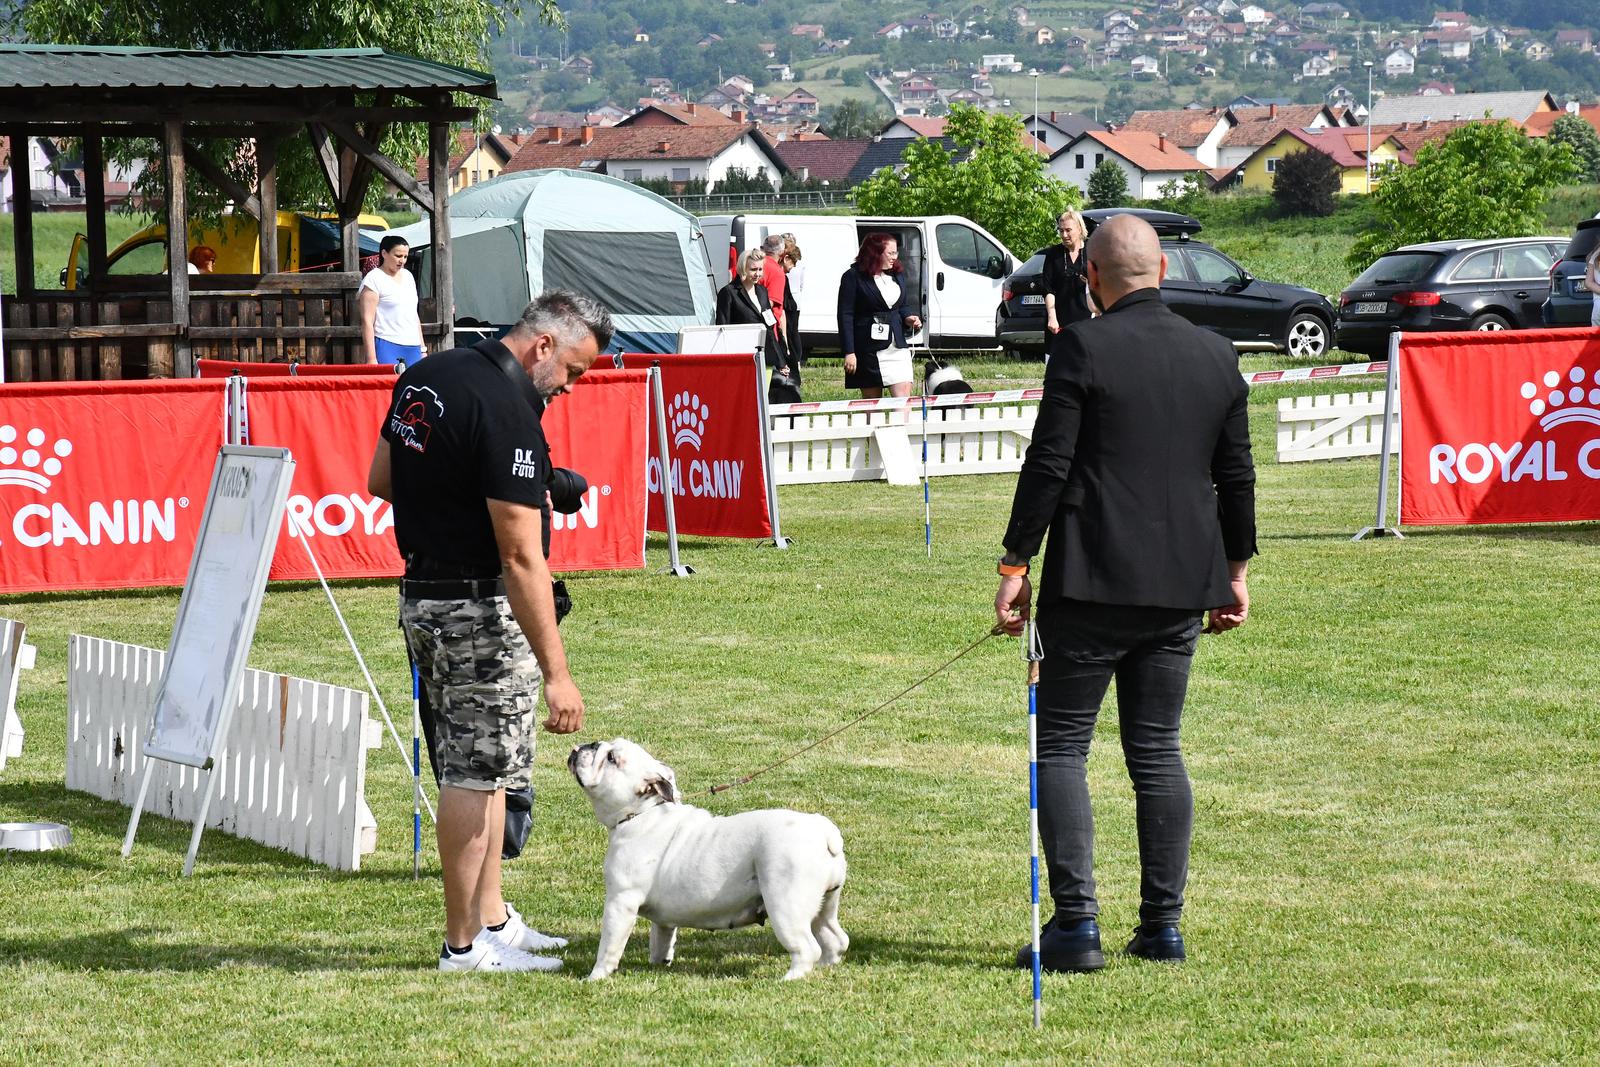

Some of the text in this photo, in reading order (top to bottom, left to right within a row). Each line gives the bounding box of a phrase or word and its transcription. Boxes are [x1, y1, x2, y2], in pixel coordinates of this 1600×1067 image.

[515, 448, 535, 465] D.K.
[1429, 439, 1568, 484] ROYAL
[512, 462, 535, 479] FOTO
